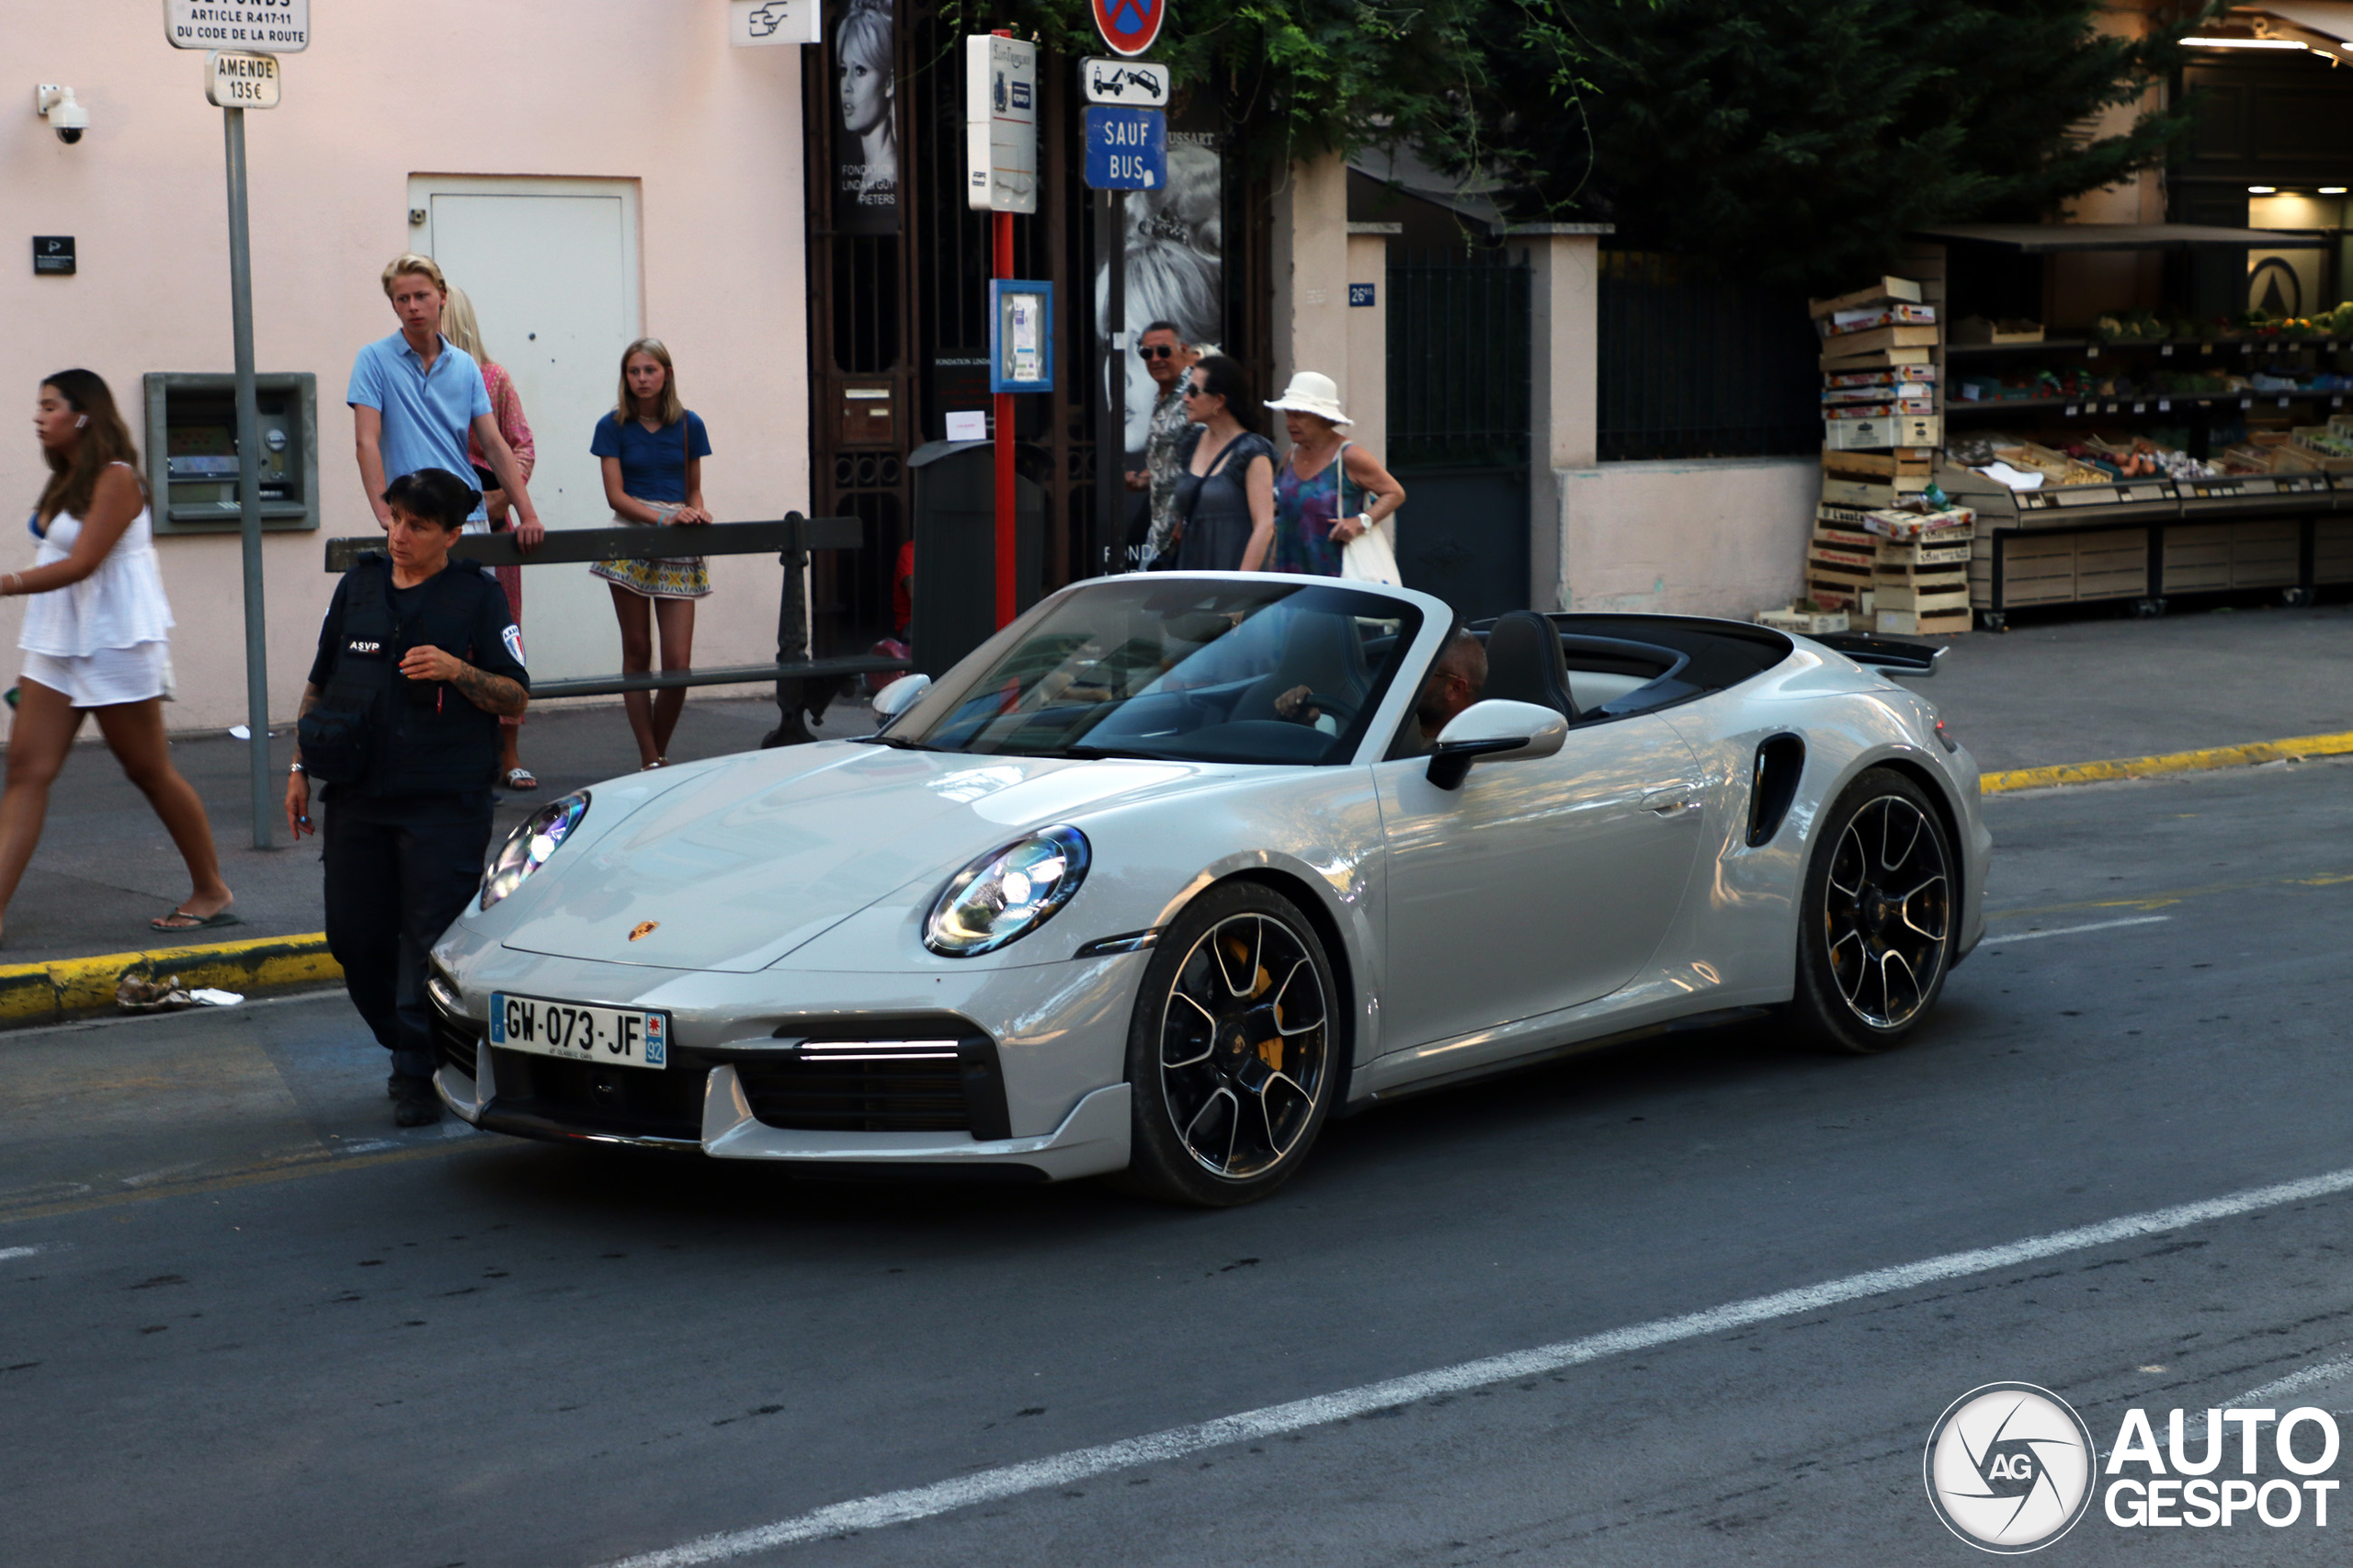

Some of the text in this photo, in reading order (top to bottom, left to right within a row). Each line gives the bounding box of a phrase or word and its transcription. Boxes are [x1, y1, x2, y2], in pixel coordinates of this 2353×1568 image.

[191, 9, 291, 25] ARTICLE R.417-11
[177, 26, 304, 42] DU CODE DE LA ROUTE
[219, 58, 273, 78] AMENDE
[230, 81, 262, 99] 135€
[1104, 120, 1149, 146] SAUF
[1167, 131, 1215, 145] USSART
[1109, 154, 1143, 179] BUS
[860, 193, 895, 205] PIETERS
[348, 641, 381, 651] ASVP
[506, 999, 642, 1057] GW-073-JF
[647, 1040, 662, 1061] 92
